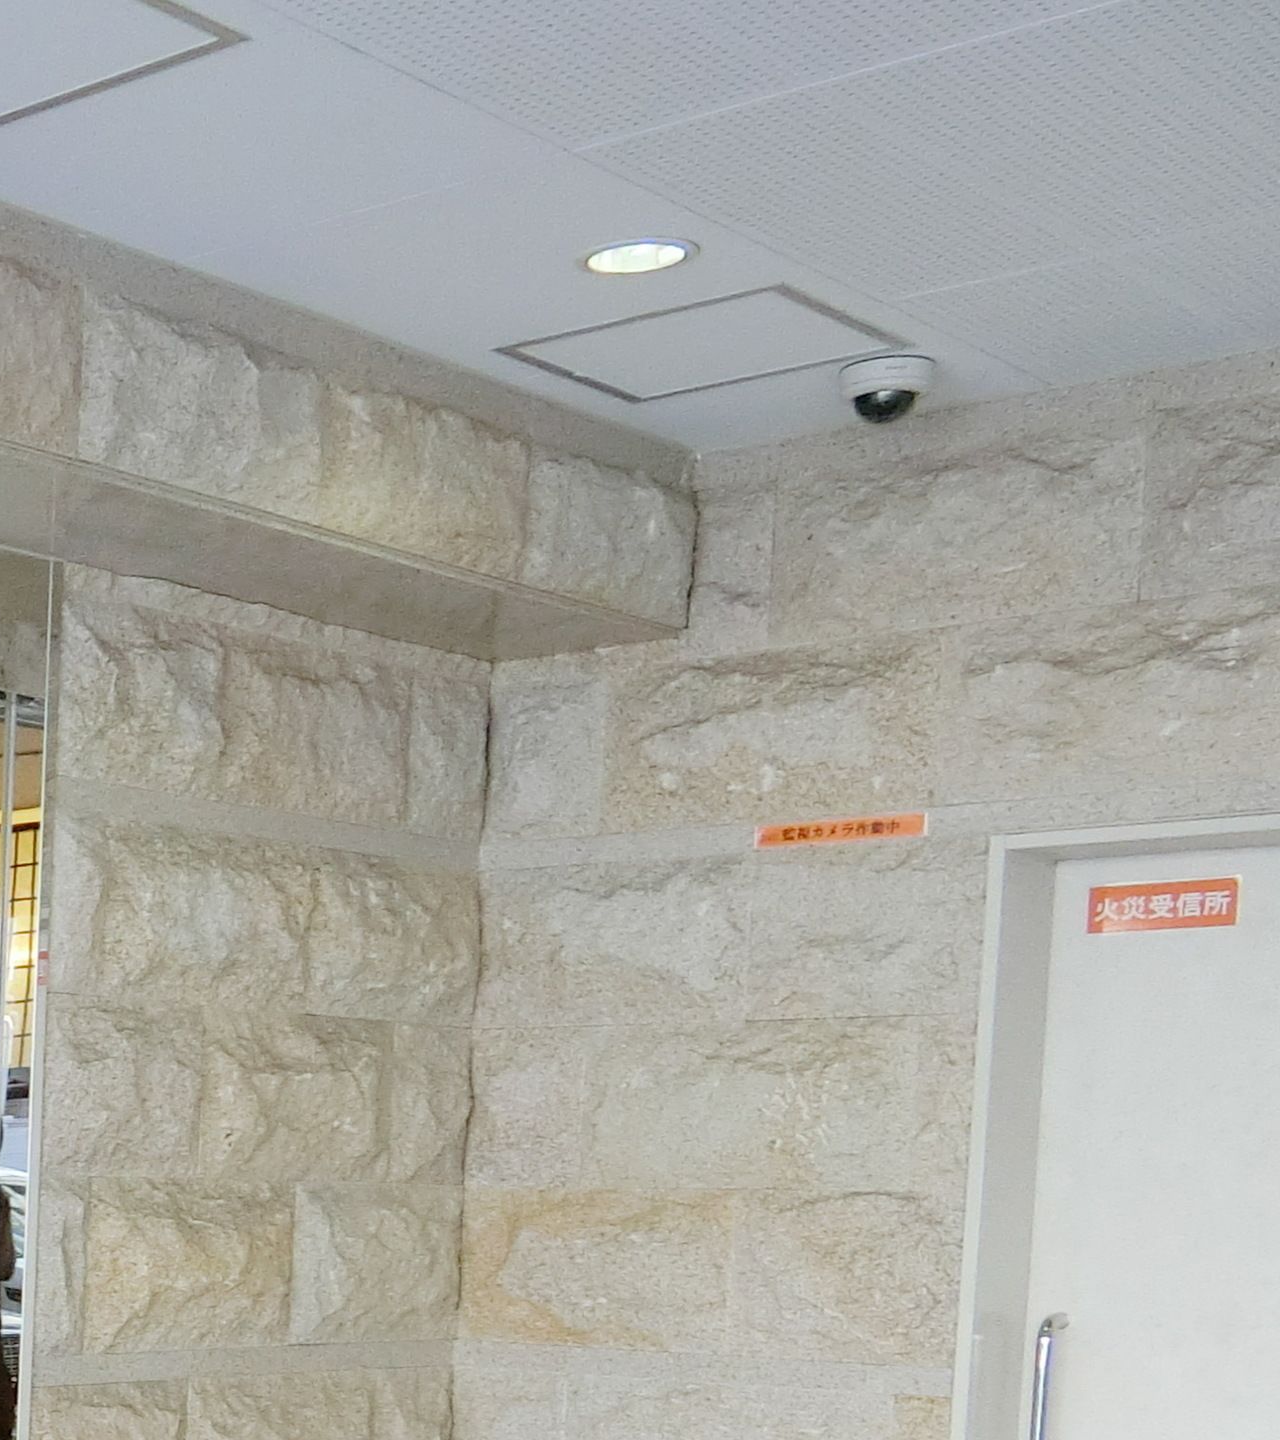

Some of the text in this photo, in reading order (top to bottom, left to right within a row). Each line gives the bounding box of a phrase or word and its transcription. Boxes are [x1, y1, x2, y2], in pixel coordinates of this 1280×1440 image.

[1094, 890, 1233, 922] 火災受信所
